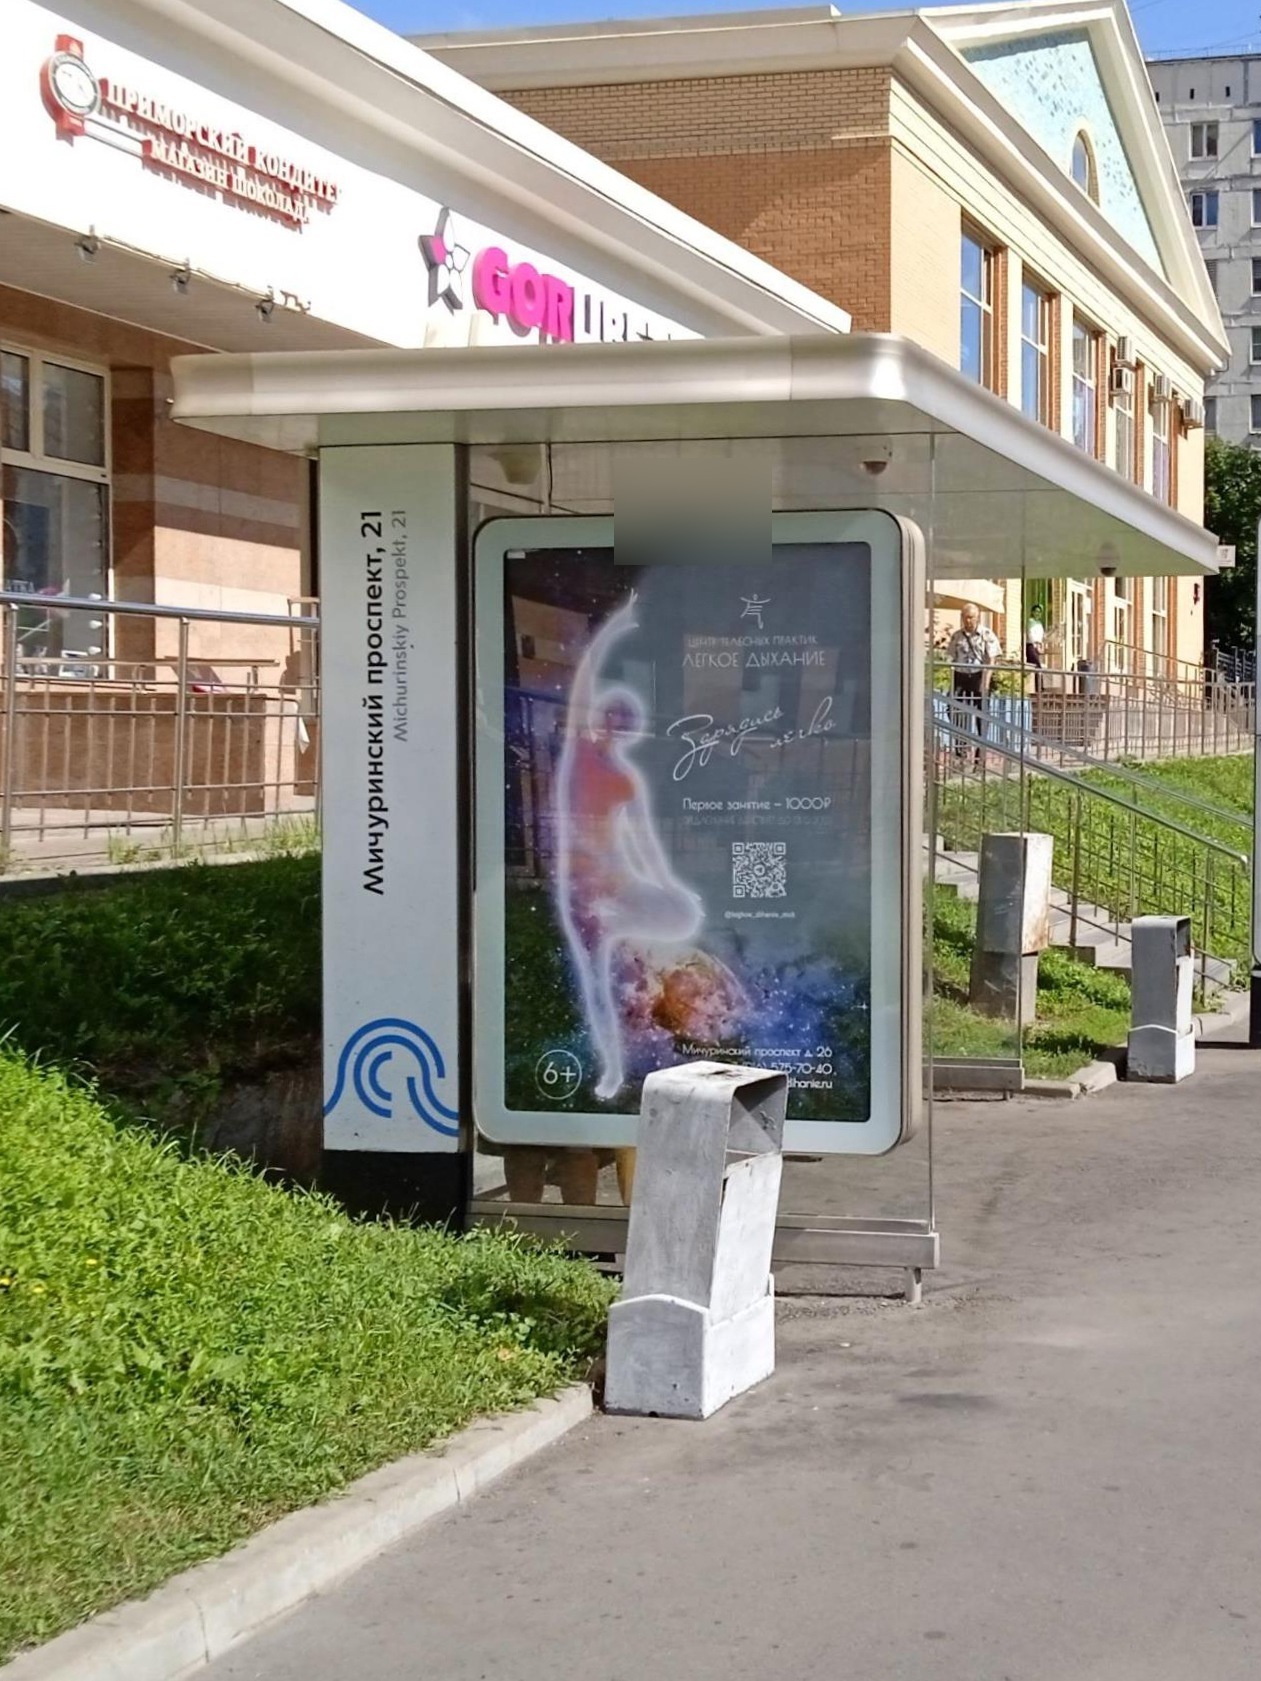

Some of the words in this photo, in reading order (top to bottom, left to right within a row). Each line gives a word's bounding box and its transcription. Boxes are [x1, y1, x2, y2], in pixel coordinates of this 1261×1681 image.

[361, 510, 383, 539] 21
[391, 509, 408, 529] 21
[392, 533, 410, 620] Prospekt,
[365, 545, 389, 685] проспект,
[682, 652, 739, 668] ЛЕГКОЕ
[745, 651, 825, 667] ДЫХАНИЕ
[393, 625, 410, 743] Michurinskiy
[362, 696, 389, 895] Мичуринский
[682, 798, 723, 812] Первое
[727, 801, 771, 810] занятие
[682, 1044, 751, 1057] Мичуринский
[755, 1047, 801, 1057] проспект
[816, 1046, 833, 1058] 26
[543, 1061, 577, 1084] 6+
